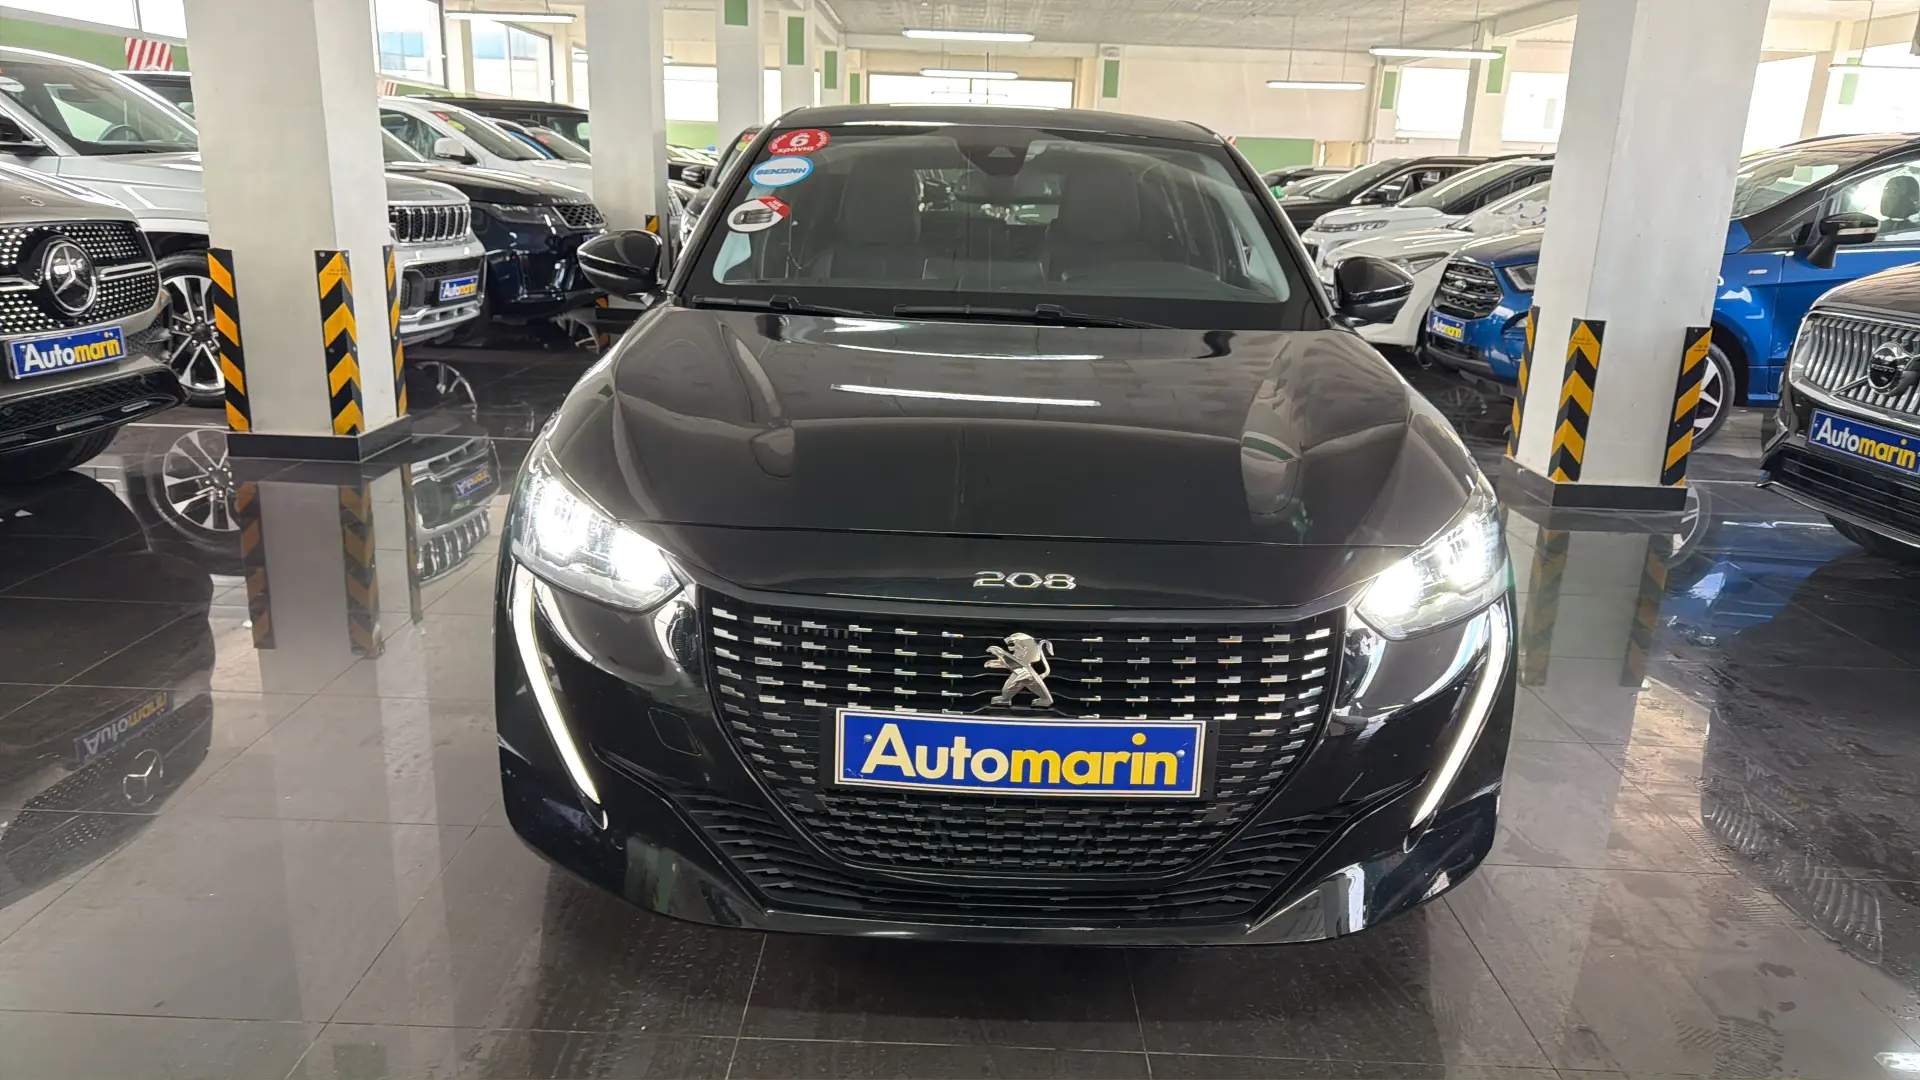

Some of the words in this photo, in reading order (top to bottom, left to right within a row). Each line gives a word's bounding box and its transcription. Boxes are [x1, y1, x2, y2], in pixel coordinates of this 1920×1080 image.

[789, 133, 811, 148] 6
[24, 332, 121, 372] Automarin
[1815, 417, 1916, 469] Automarin
[973, 571, 1077, 590] 208
[860, 723, 1179, 786] Automarin
